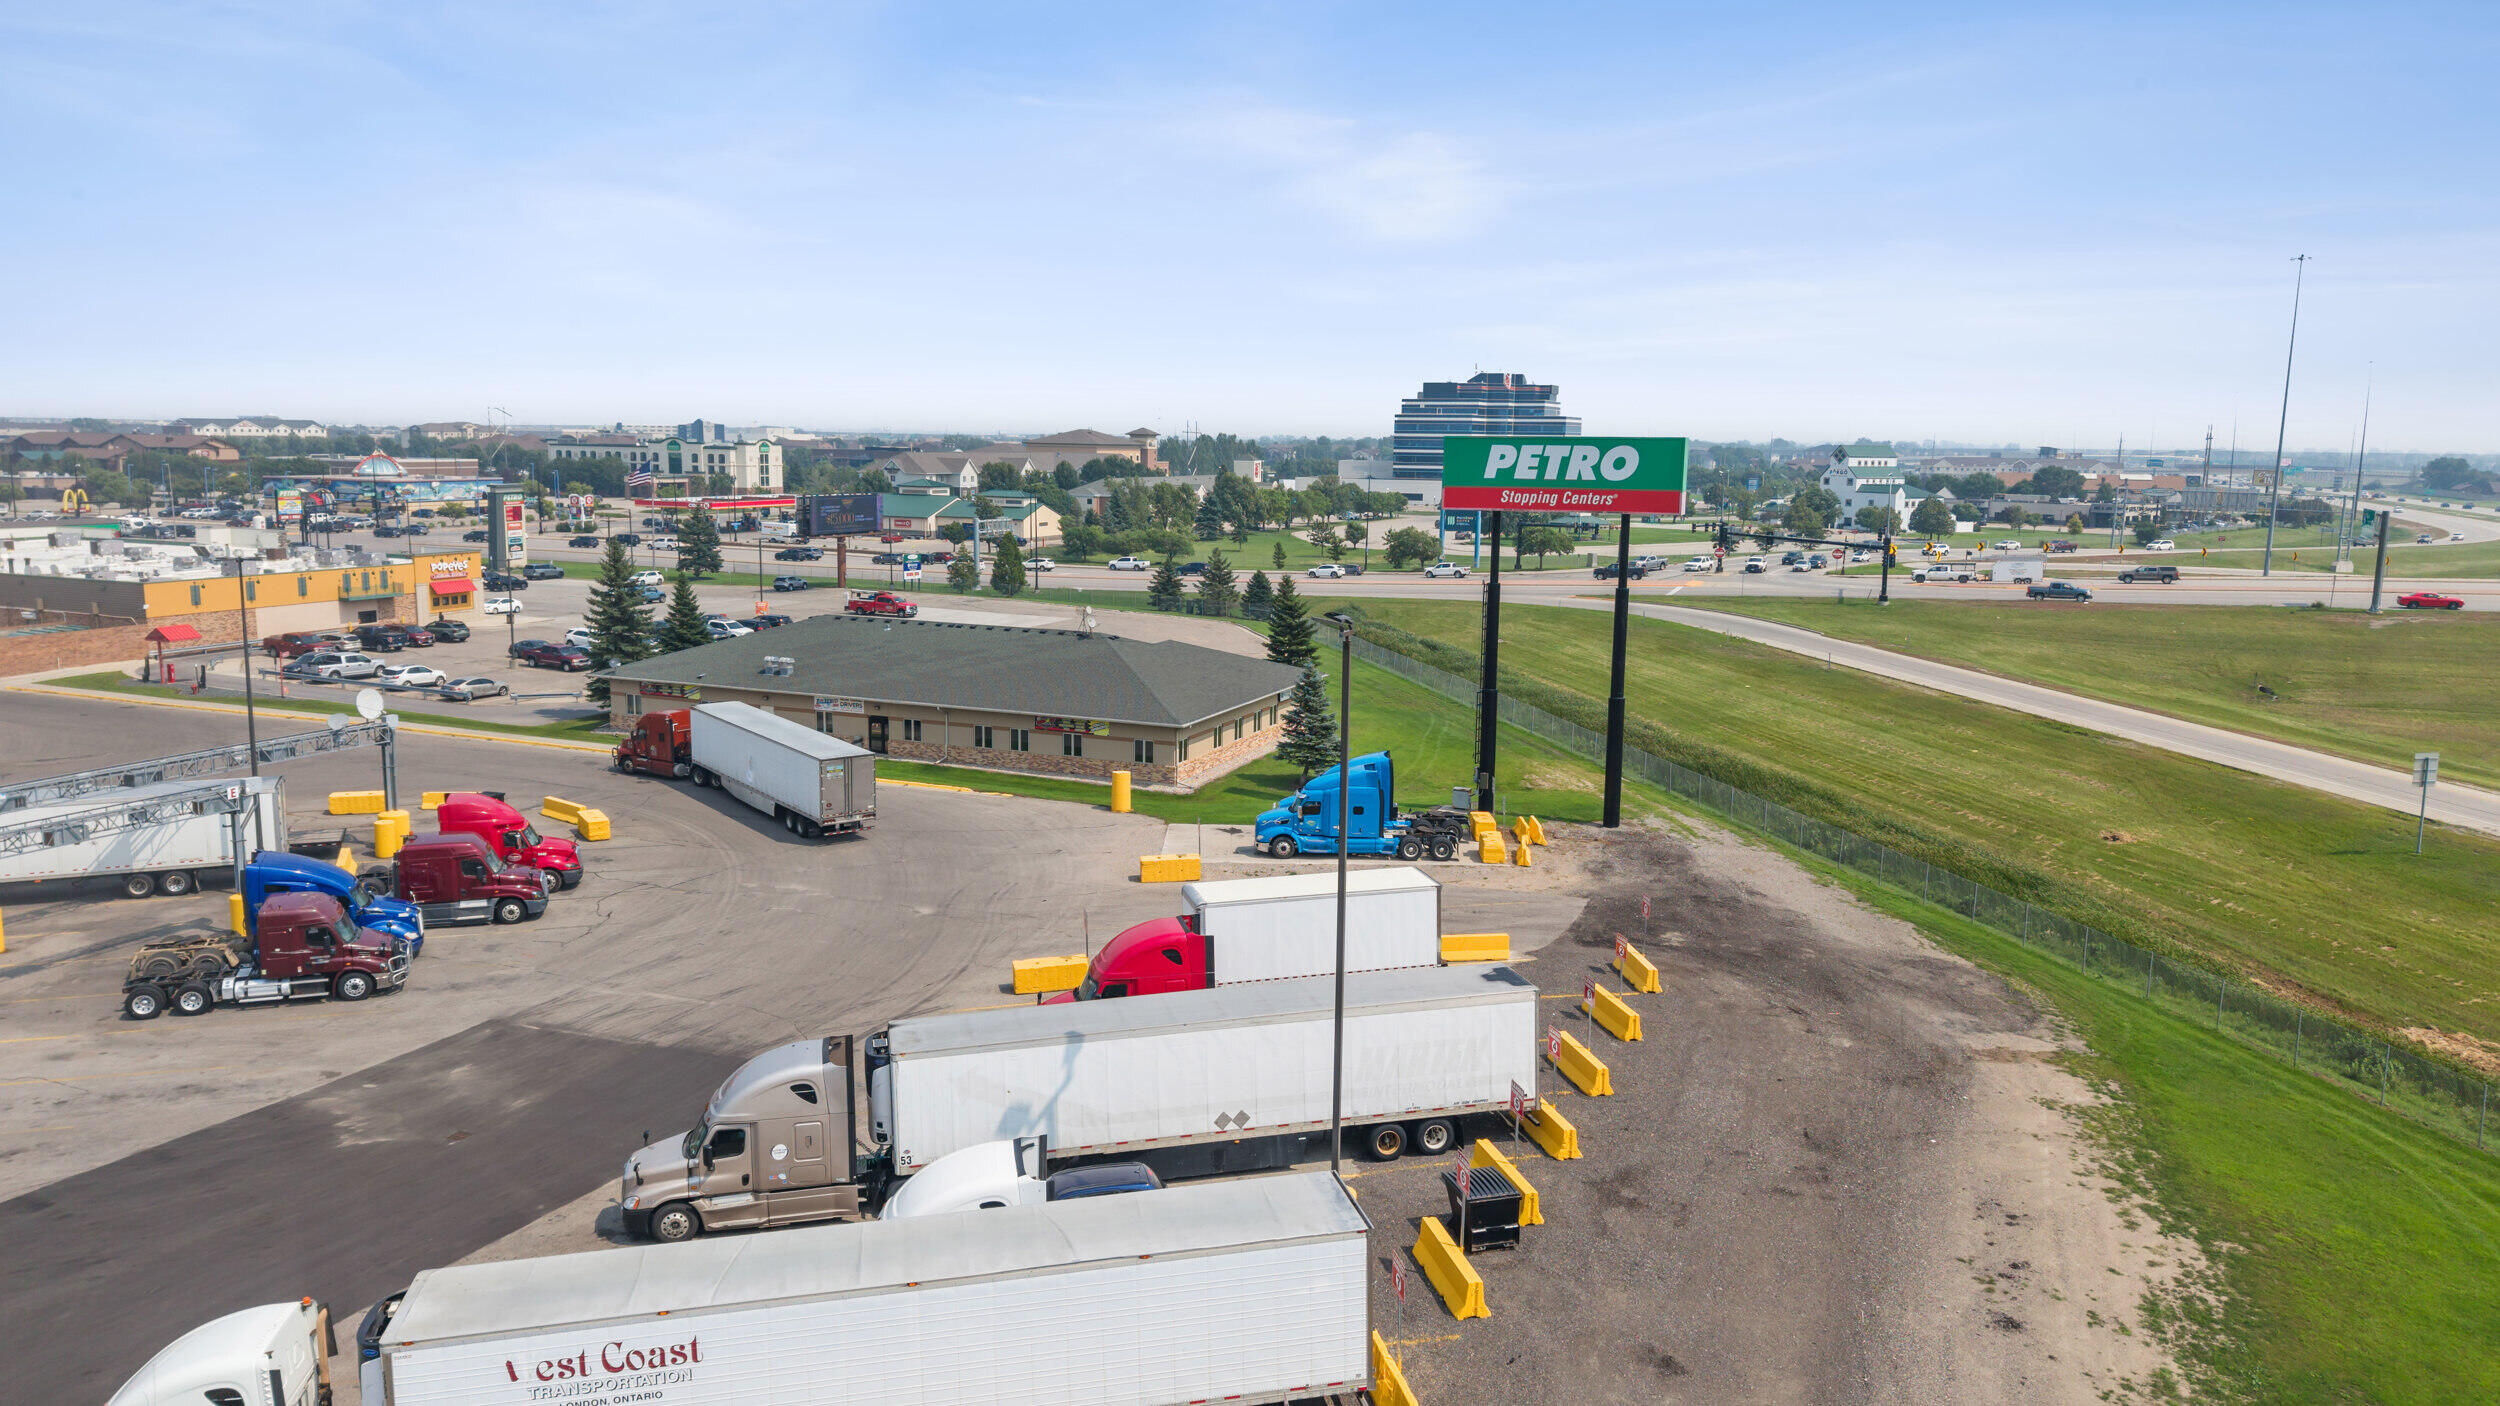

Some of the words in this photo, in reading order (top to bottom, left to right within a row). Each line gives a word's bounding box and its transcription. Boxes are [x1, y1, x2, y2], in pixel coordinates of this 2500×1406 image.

[1483, 444, 1640, 482] PETRO
[279, 489, 300, 497] PETRO
[1501, 490, 1559, 507] Stopping
[430, 560, 468, 572] POPEYES
[230, 787, 236, 798] E
[900, 1156, 912, 1165] 53
[601, 1334, 704, 1374] Coast
[527, 1368, 694, 1401] TRANSPORTATION
[613, 1390, 663, 1405] ONTARIO
